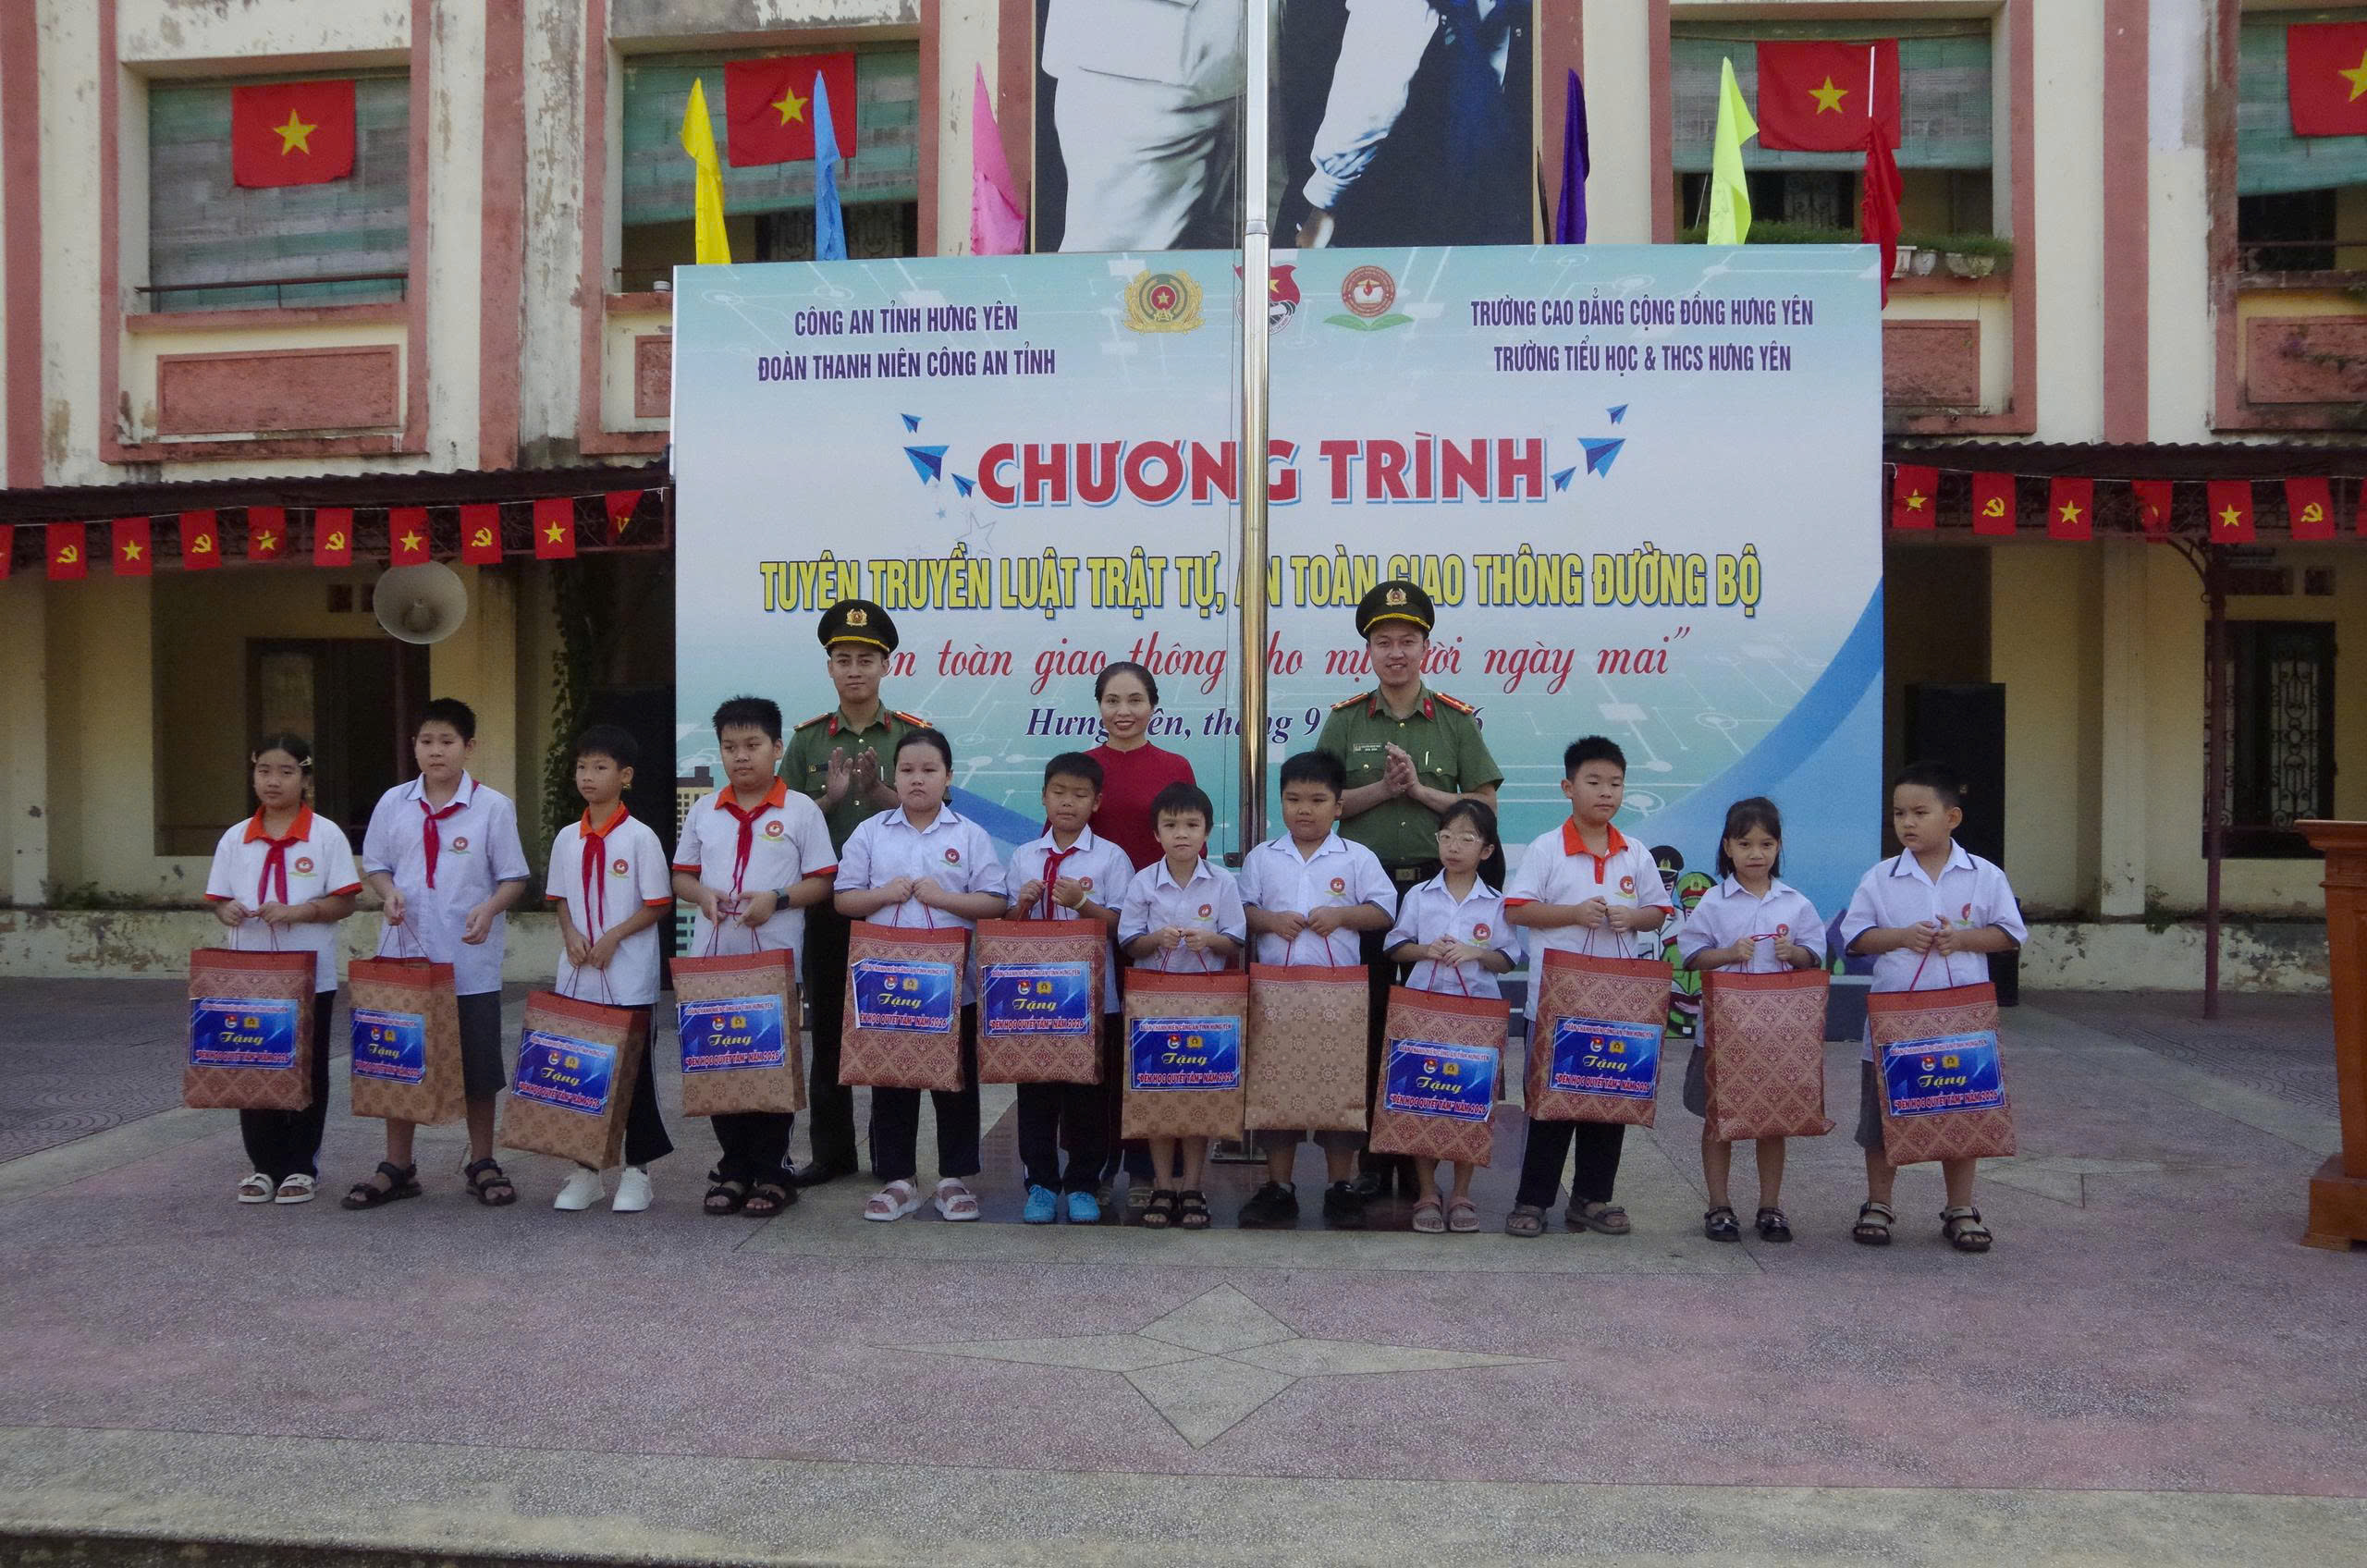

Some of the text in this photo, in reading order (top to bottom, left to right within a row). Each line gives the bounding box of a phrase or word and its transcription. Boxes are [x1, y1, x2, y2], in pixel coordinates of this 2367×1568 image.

[795, 300, 1018, 336] CÔNG AN TỈNH HƯNG YÊN
[1471, 287, 1813, 331] TRƯỜNG CAO ĐẲNG CỘNG ĐỒNG HƯNG YÊN
[758, 341, 1055, 381] ĐOÀN THANH NIÊN CÔNG AN TỈNH
[1494, 335, 1790, 377] TRƯỜNG TIỂU HỌC & THCS HƯNG YÊN
[977, 431, 1548, 507] CHƯƠNG TRÌNH
[760, 550, 859, 611] TUYÊN
[868, 543, 990, 611] TRUYỀN
[1000, 547, 1079, 619] LUẬT
[1086, 546, 1167, 619] TRẬT
[1175, 551, 1225, 619] TỰ,
[1290, 545, 1377, 606] TOÀN
[1473, 544, 1584, 607] THÔNG
[1592, 542, 1706, 607] ĐƯỜNG
[1716, 544, 1762, 618] BỘ
[938, 639, 1012, 677] toàn
[1030, 638, 1108, 695] giao
[1129, 631, 1227, 694] thông
[1268, 631, 1303, 675] ho
[1325, 649, 1372, 682] nụ
[1484, 640, 1575, 694] ngày
[1147, 708, 1191, 741] ên,
[1303, 707, 1321, 736] 9
[877, 994, 922, 1008] Tặng
[1013, 998, 1057, 1011] Tặng
[219, 1031, 264, 1046] Tặng
[707, 1034, 752, 1047] Tặng
[1161, 1052, 1208, 1065] Tặng
[1583, 1056, 1627, 1072] Tặng
[540, 1067, 580, 1086] Tặng
[1416, 1076, 1462, 1095] Tặng
[1918, 1074, 1968, 1088] Tặng
